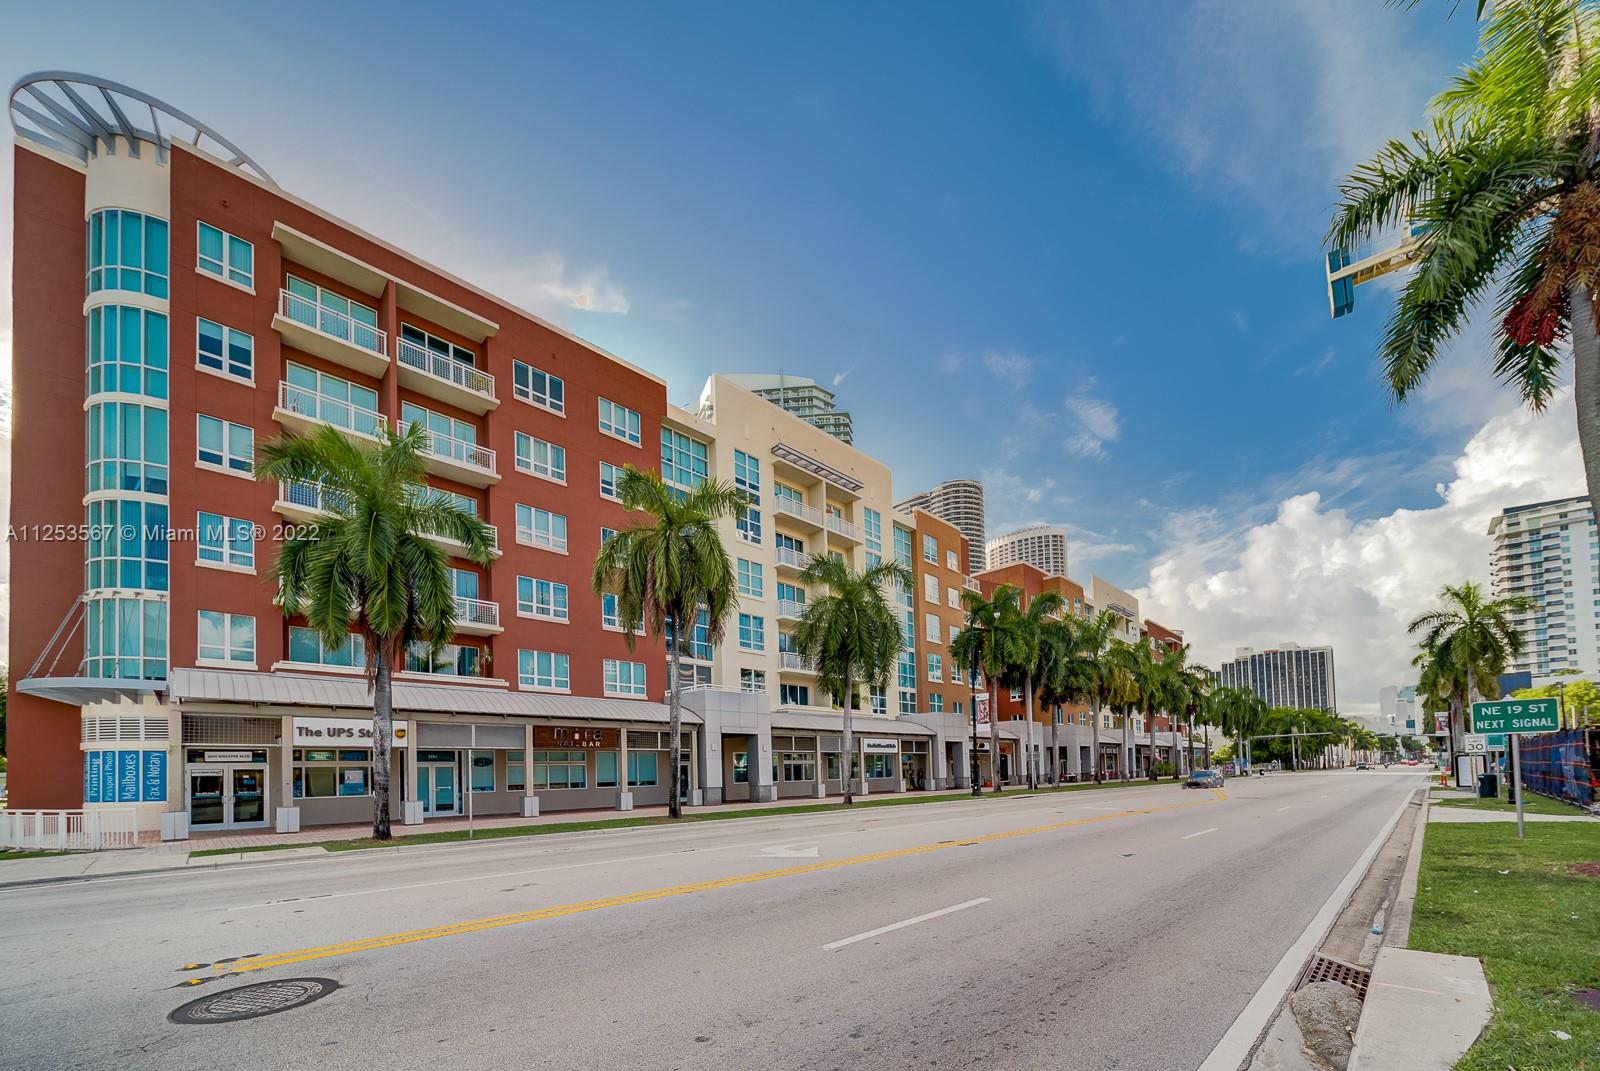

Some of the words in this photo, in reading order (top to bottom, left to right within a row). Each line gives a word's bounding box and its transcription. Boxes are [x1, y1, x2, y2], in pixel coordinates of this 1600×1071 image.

[1481, 706, 1501, 716] NE
[1506, 705, 1522, 714] 19
[1528, 703, 1548, 713] ST
[1476, 720, 1505, 729] NEXT
[1512, 718, 1555, 728] SIGNAL
[296, 726, 322, 737] The
[327, 727, 354, 738] UPS
[1467, 743, 1484, 751] 30
[105, 752, 113, 771] Photo
[147, 752, 163, 777] Notary
[90, 758, 101, 797] Printing
[122, 754, 137, 800] Mailboxes
[105, 772, 115, 801] Passport
[146, 787, 160, 800] Fax
